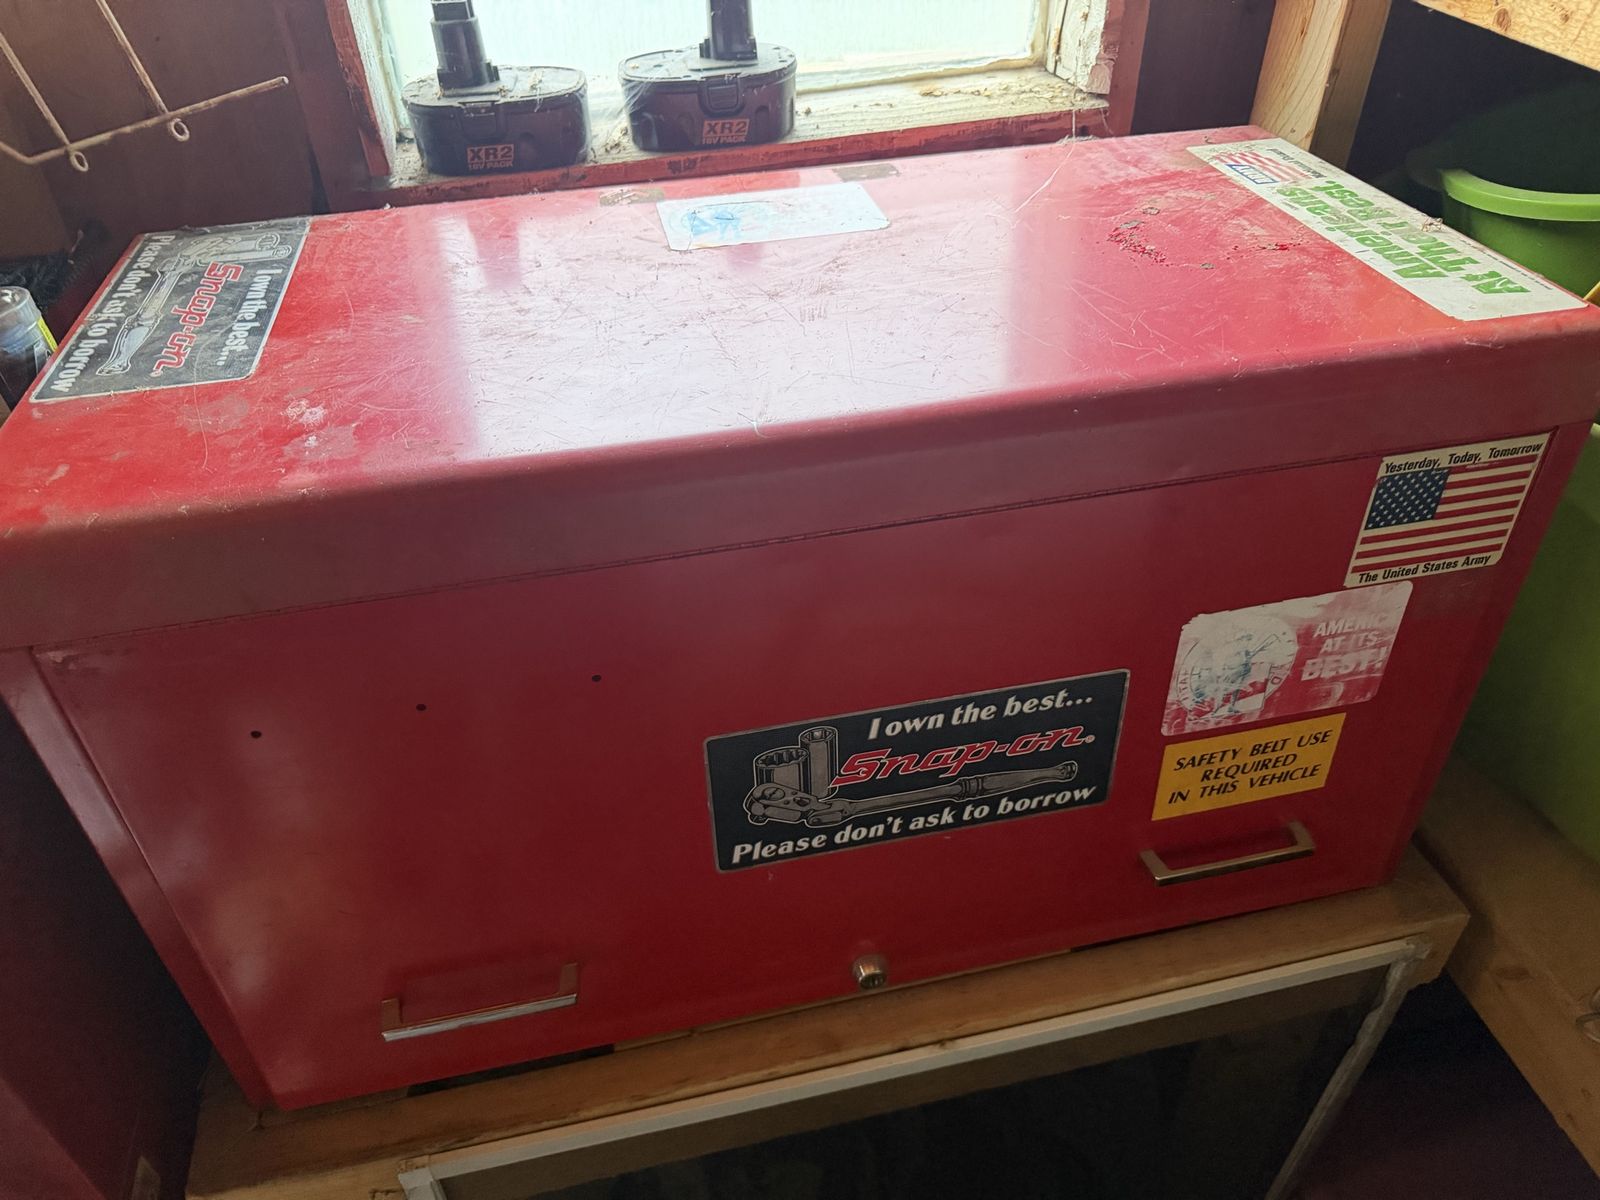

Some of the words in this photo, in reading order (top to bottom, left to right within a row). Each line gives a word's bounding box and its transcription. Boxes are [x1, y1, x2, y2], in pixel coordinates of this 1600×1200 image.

[705, 120, 748, 136] XR2
[469, 145, 513, 162] XR2
[1311, 180, 1397, 220] Best.
[1276, 186, 1449, 278] Americans
[1376, 221, 1480, 272] Their
[134, 235, 176, 270] Please
[116, 269, 151, 299] don't
[249, 274, 271, 300] own
[1459, 271, 1531, 294] At
[101, 299, 127, 323] ask
[239, 300, 267, 323] the
[87, 322, 117, 338] to
[51, 338, 109, 392] borrow
[1384, 458, 1441, 473] Yesterday,
[1448, 452, 1481, 465] Today,
[1488, 443, 1543, 459] Tomorrow
[1359, 573, 1377, 584] The
[1383, 565, 1418, 579] United
[1422, 559, 1458, 573] States
[1461, 555, 1491, 567] Army
[868, 718, 882, 739] I
[885, 712, 944, 736] own
[952, 701, 998, 725] the
[1003, 688, 1093, 718] best...
[1174, 748, 1242, 771] SAFETY
[1249, 738, 1290, 757] BELT
[1297, 730, 1333, 747] USE
[1200, 754, 1297, 783] REQUIRED
[1168, 789, 1189, 804] IN
[1200, 780, 1239, 798] THIS
[1249, 764, 1322, 789] VEHICLE
[731, 835, 827, 865] Please
[834, 816, 904, 845] don't
[909, 806, 955, 832] ask
[963, 802, 990, 820] to
[997, 785, 1097, 817] borrow
